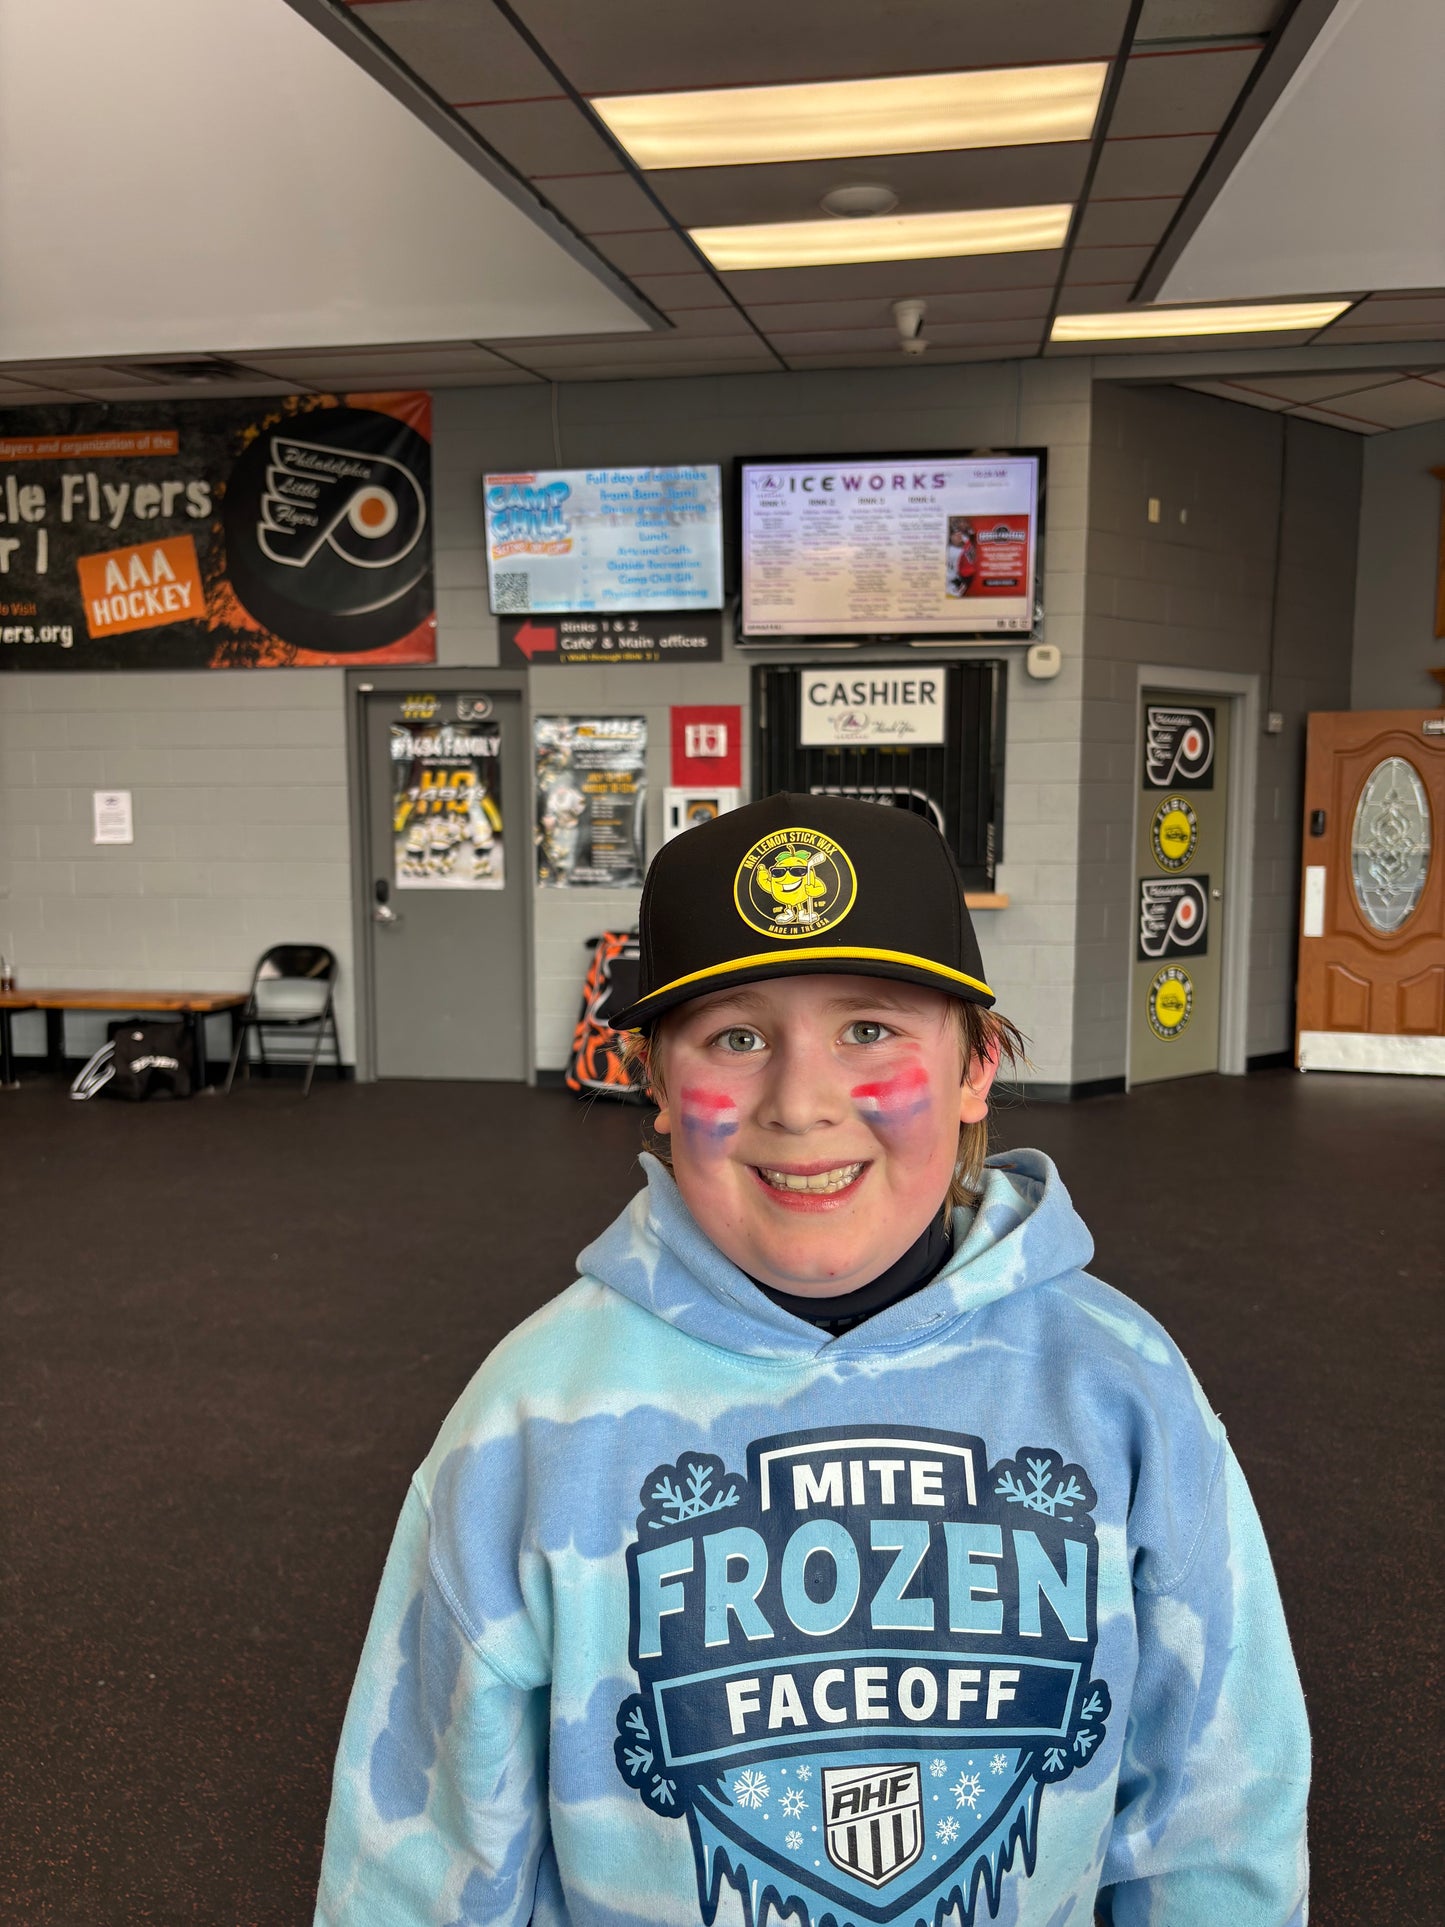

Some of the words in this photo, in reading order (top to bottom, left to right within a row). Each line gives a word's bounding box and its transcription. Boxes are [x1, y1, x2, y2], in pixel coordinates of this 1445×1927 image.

[153, 435, 173, 449] the
[61, 472, 213, 529] Flyers
[486, 482, 571, 512] CAMP
[491, 508, 571, 541] CHILL
[105, 549, 176, 595] AAA
[92, 581, 192, 626] HOCKEY
[560, 621, 598, 633] Rinks
[602, 621, 609, 633] 1
[613, 620, 625, 632] &
[629, 619, 639, 632] 2
[601, 637, 614, 649] &
[618, 636, 655, 649] Main
[659, 634, 709, 648] offices
[808, 681, 936, 706] CASHIER
[744, 854, 760, 870] MR.
[756, 832, 788, 855] LEMON
[790, 831, 817, 844] STICK
[816, 837, 838, 856] WAX
[768, 925, 787, 934] MADE
[801, 925, 815, 933] THE
[815, 918, 830, 928] USA
[792, 1460, 945, 1510] MITE
[636, 1519, 1088, 1659] FROZEN
[725, 1667, 1021, 1736] FACEOFF
[832, 1772, 915, 1820] AHF
